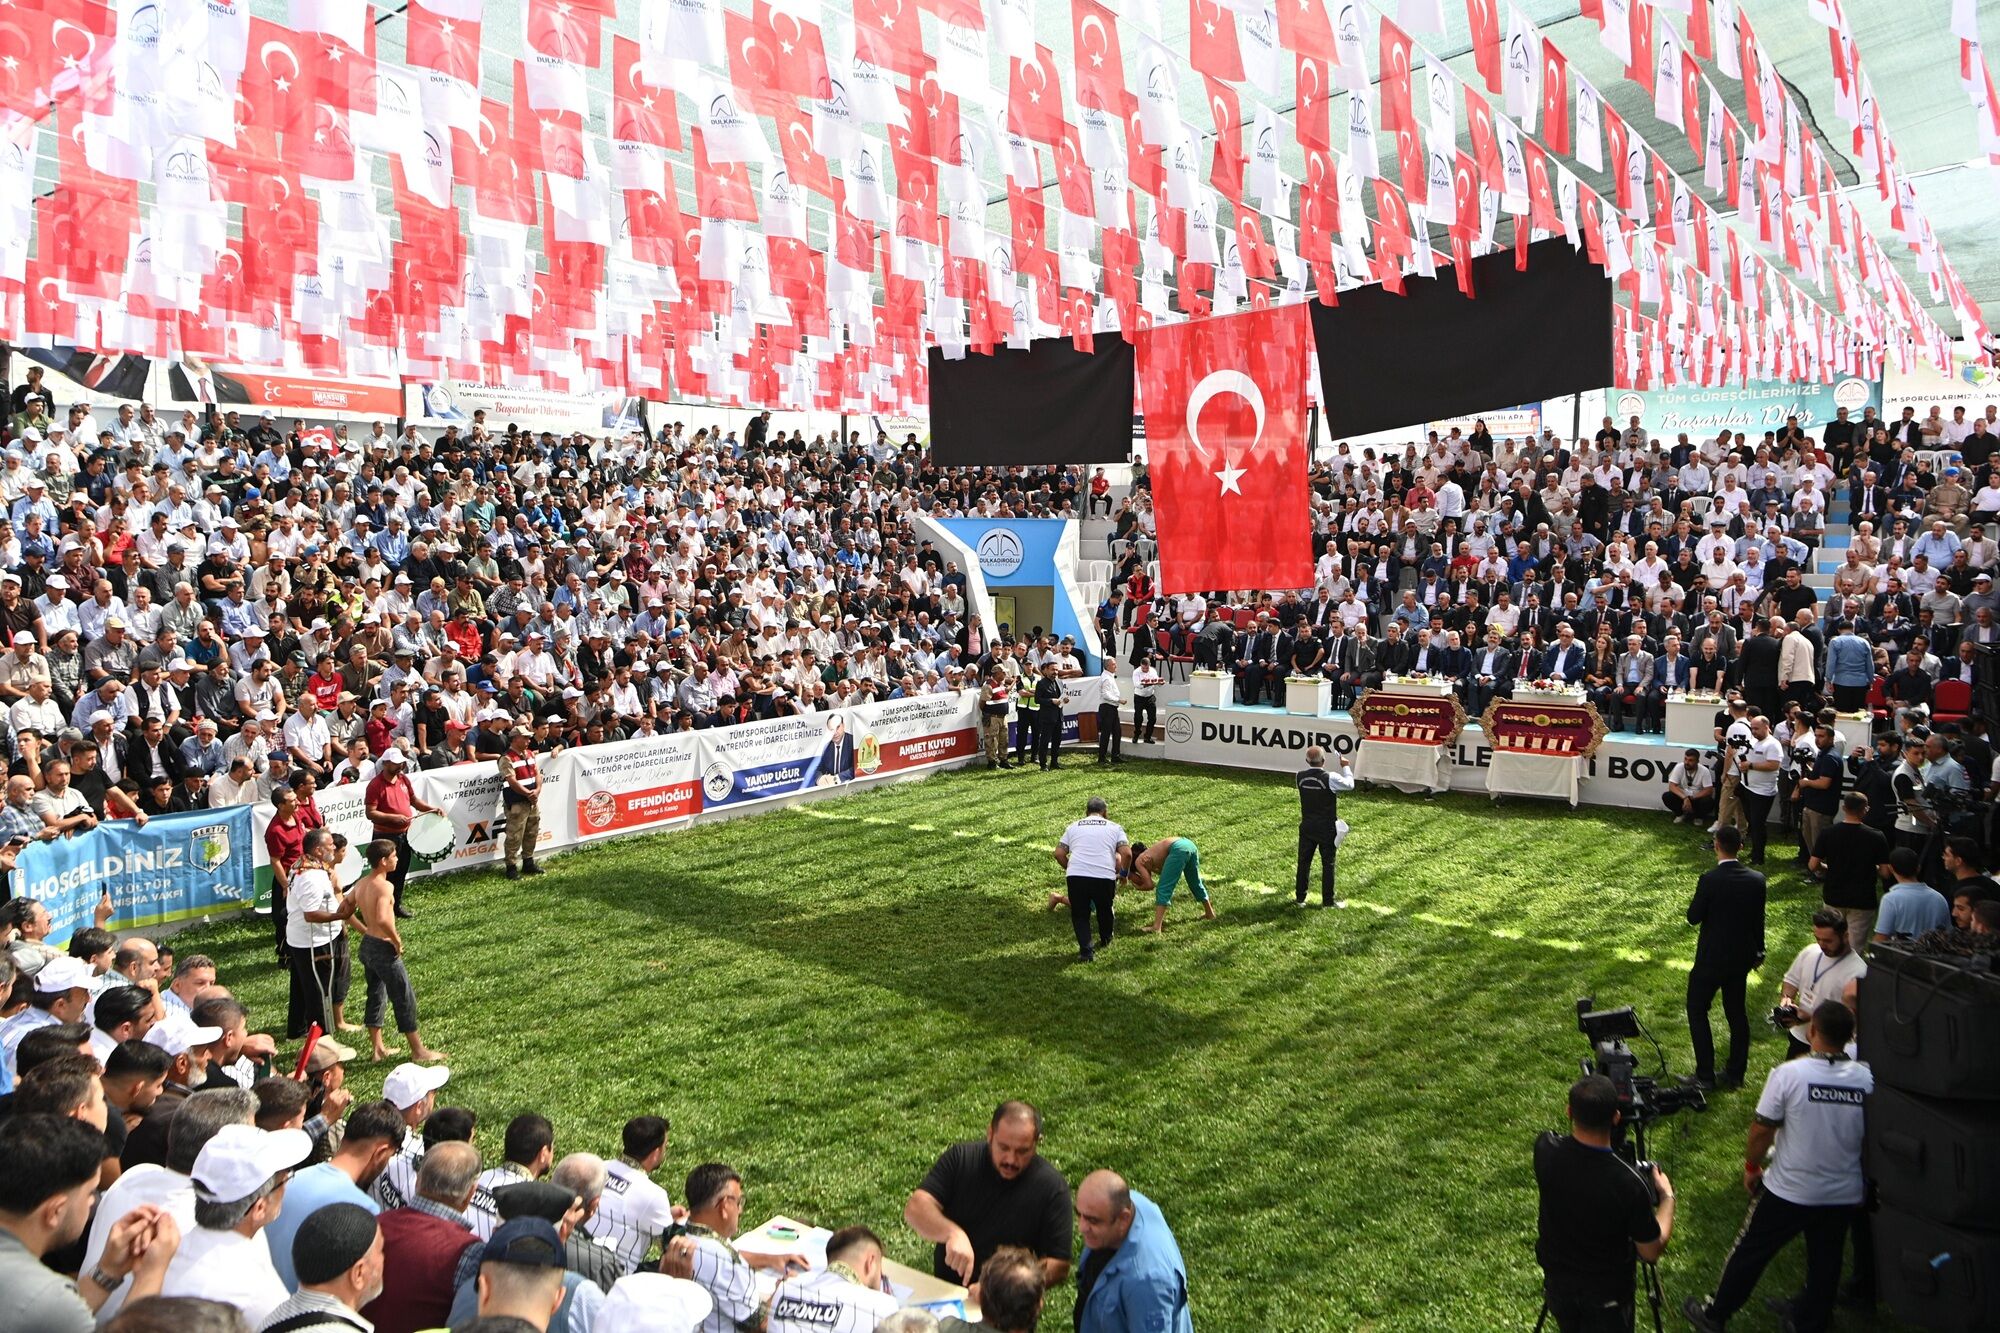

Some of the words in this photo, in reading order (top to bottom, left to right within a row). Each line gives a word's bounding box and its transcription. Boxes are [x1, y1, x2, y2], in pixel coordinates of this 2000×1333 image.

[729, 730, 745, 740] TÜM
[715, 739, 754, 753] ANTRENÖR
[899, 742, 927, 756] AHMET
[928, 736, 957, 750] KUYBU
[596, 755, 613, 765] TÜM
[581, 764, 622, 777] ANTRENÖR
[745, 773, 773, 787] YAKUP
[775, 767, 800, 780] UĞUR
[459, 779, 478, 789] TÜM
[443, 787, 486, 800] ANTRENÖR
[627, 788, 693, 811] EFENDİOĞLU
[318, 799, 365, 814] PORCULA
[455, 843, 500, 859] MEGA
[48, 904, 73, 919] ERTİZ
[1811, 1087, 1863, 1104] ÖZÜNLÜ
[777, 1299, 839, 1324] ÖZÜNLÜ
